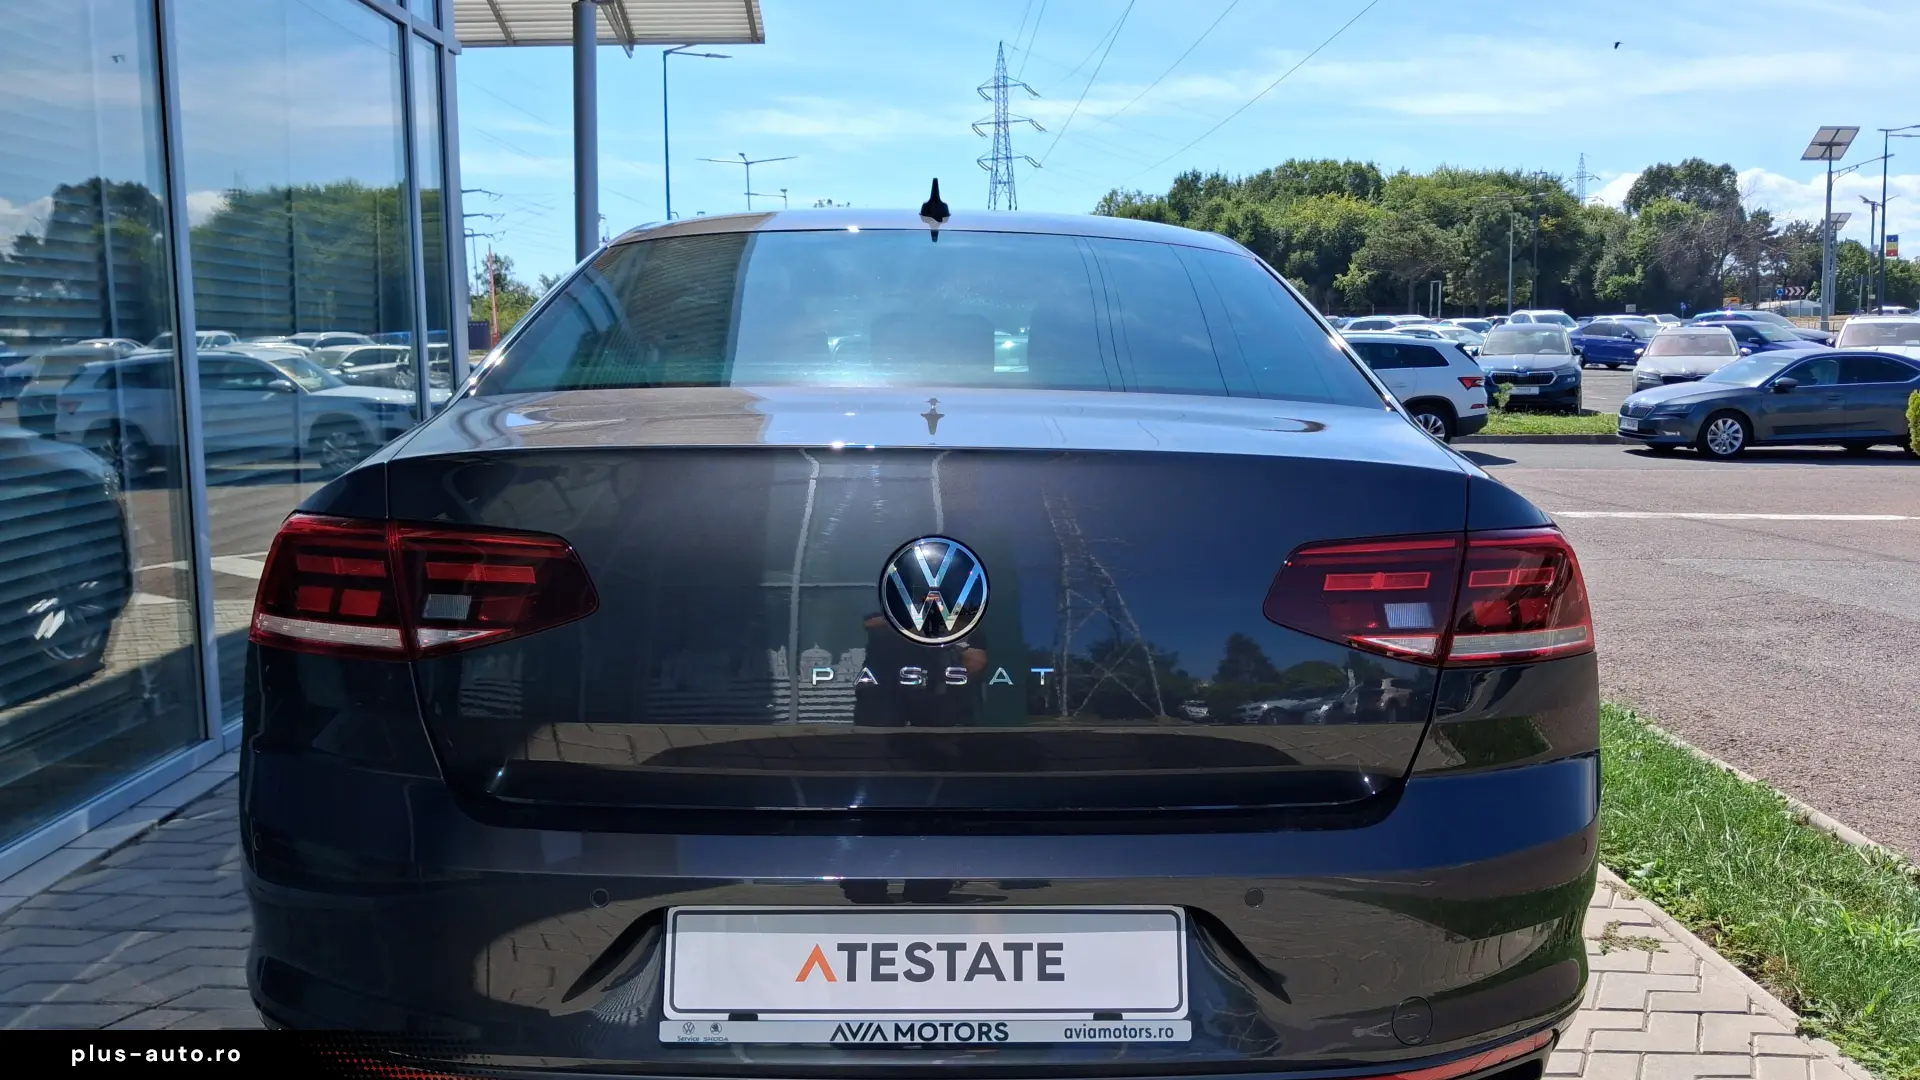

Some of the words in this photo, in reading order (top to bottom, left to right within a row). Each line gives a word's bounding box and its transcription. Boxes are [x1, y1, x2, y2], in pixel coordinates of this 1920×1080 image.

[811, 666, 1055, 686] PASSAT
[795, 942, 1065, 982] ATESTATE
[829, 1022, 888, 1042] AVIA
[894, 1022, 1009, 1042] MOTORS
[1063, 1023, 1174, 1041] aviamotors.ro
